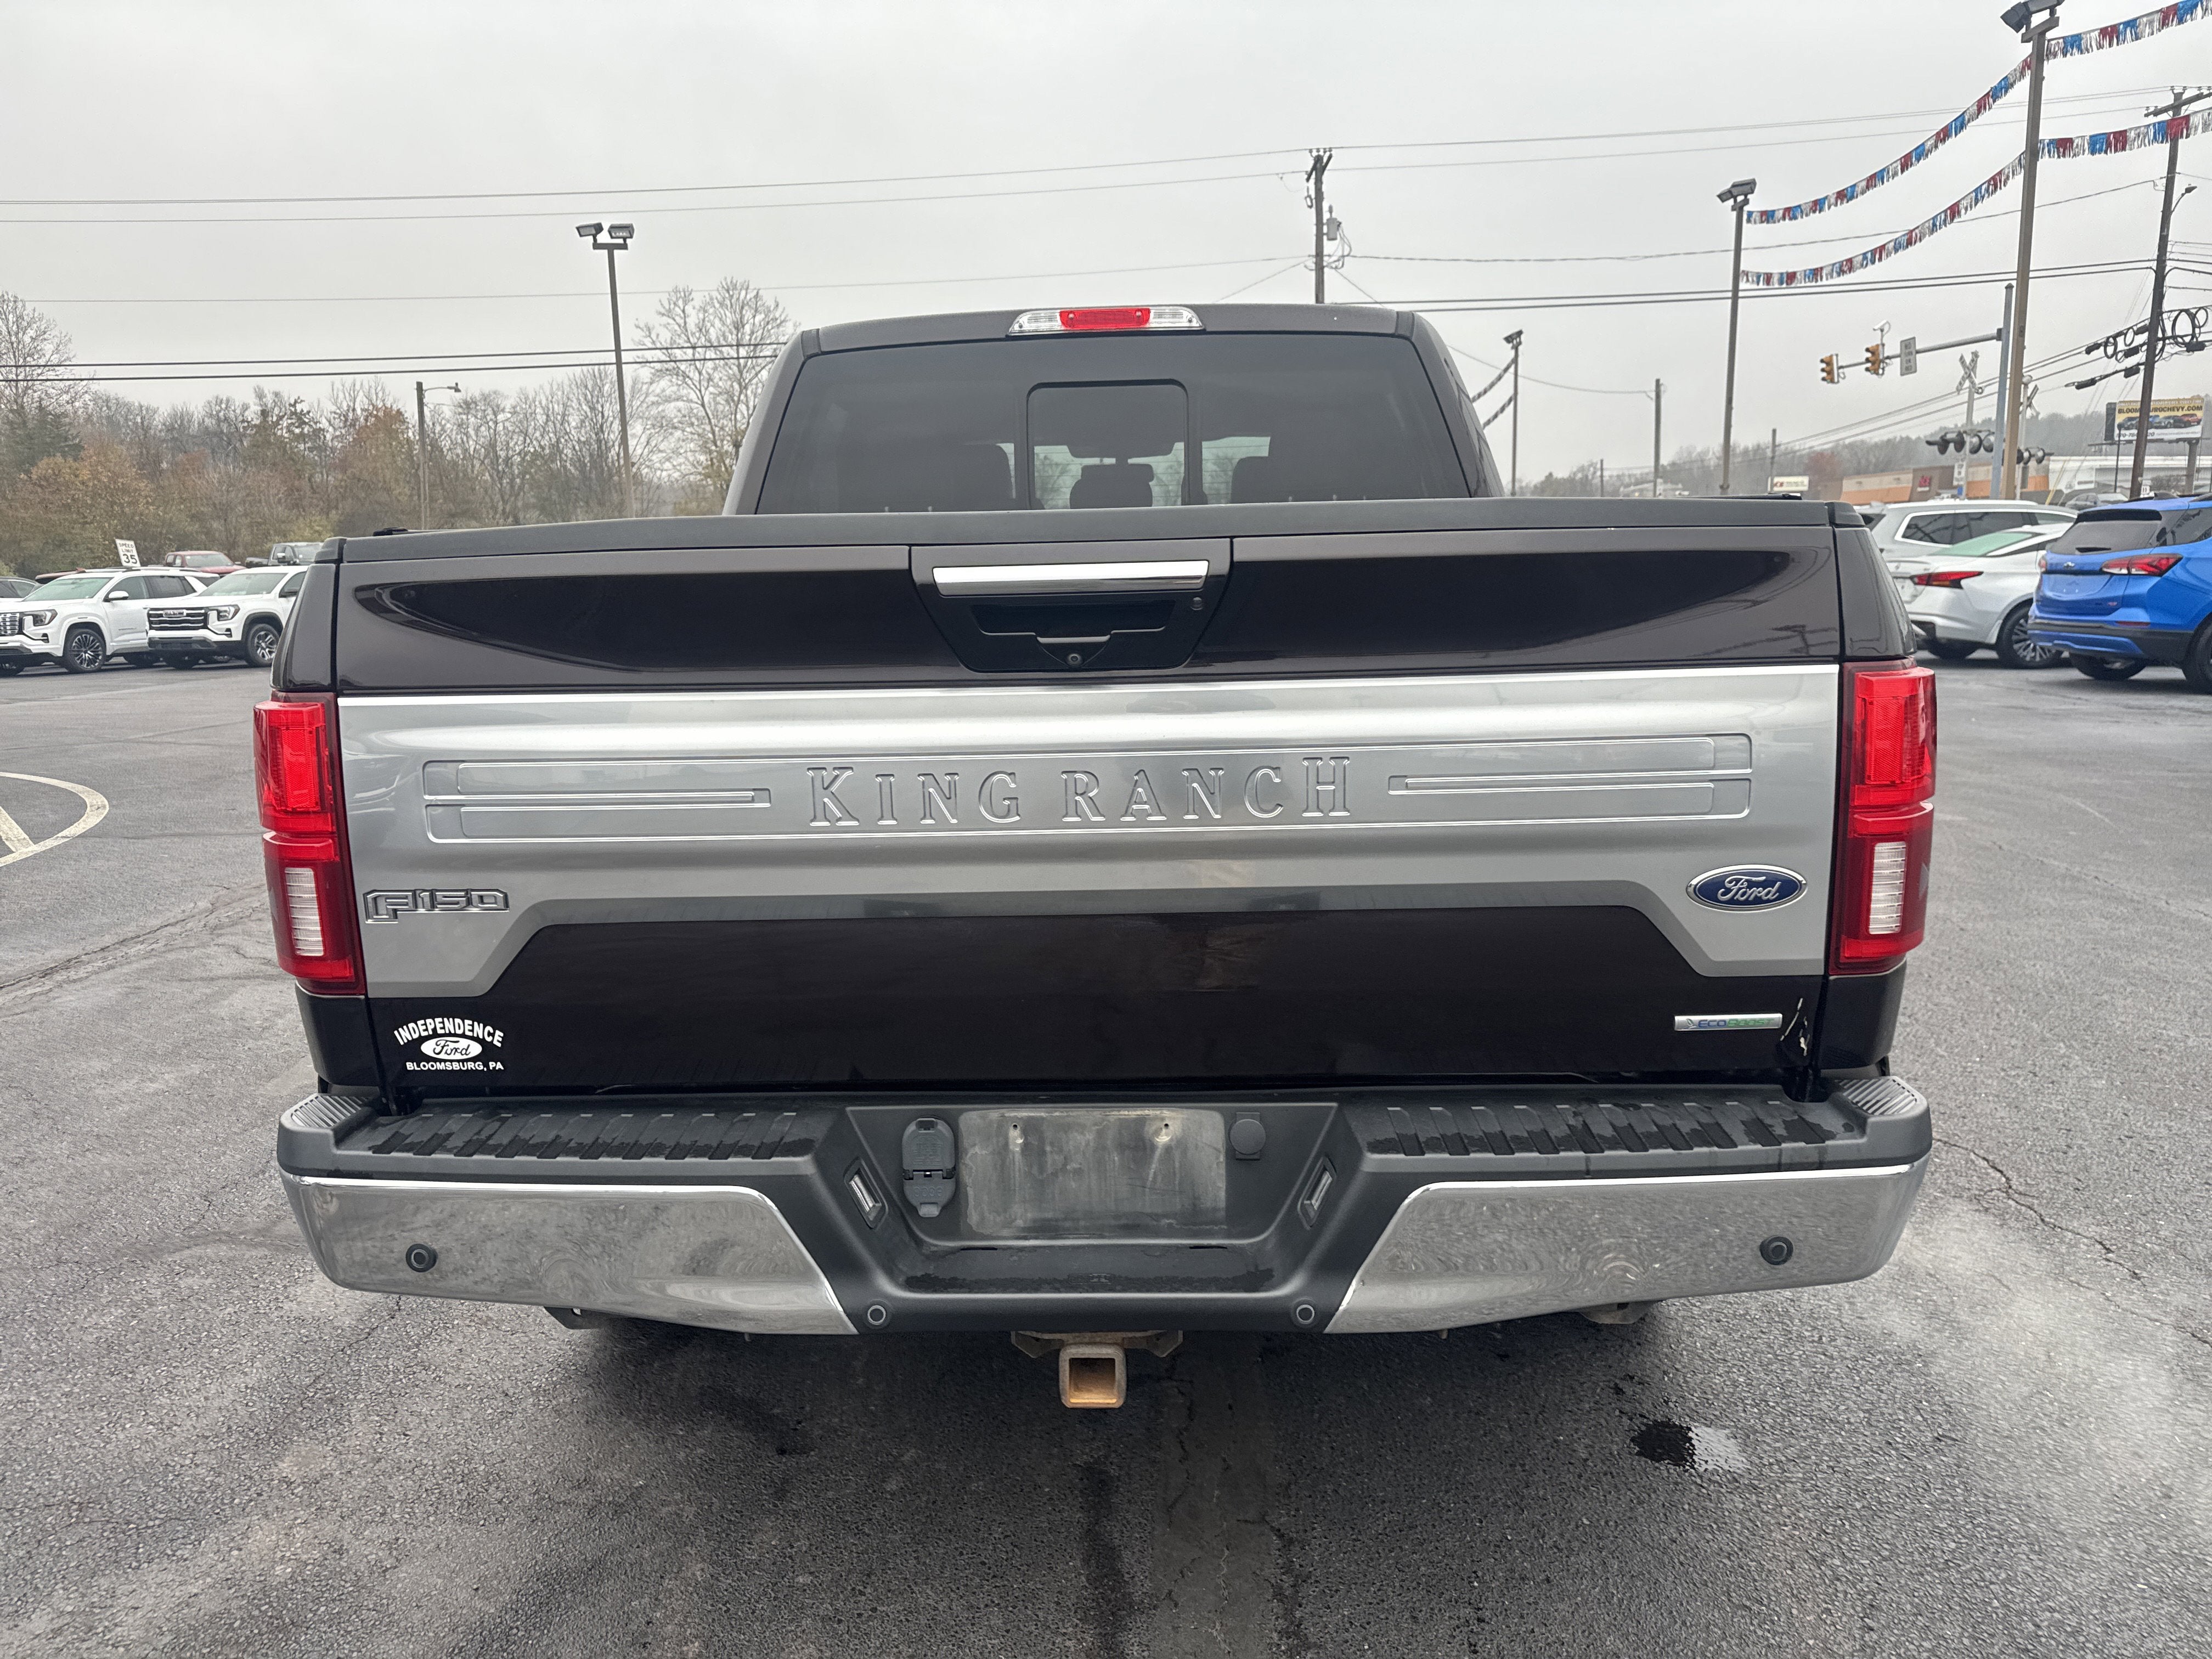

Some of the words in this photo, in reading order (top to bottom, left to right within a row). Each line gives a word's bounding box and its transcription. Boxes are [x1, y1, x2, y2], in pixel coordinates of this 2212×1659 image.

[123, 554, 138, 564] 35
[806, 766, 1021, 826] KING
[1061, 757, 1350, 822] RANCH
[1717, 875, 1782, 901] Ford
[393, 1018, 504, 1048] INDEPENDENCE
[432, 1039, 471, 1056] Ford
[406, 1062, 487, 1071] BLOOMSBURG,
[488, 1061, 504, 1070] PA
